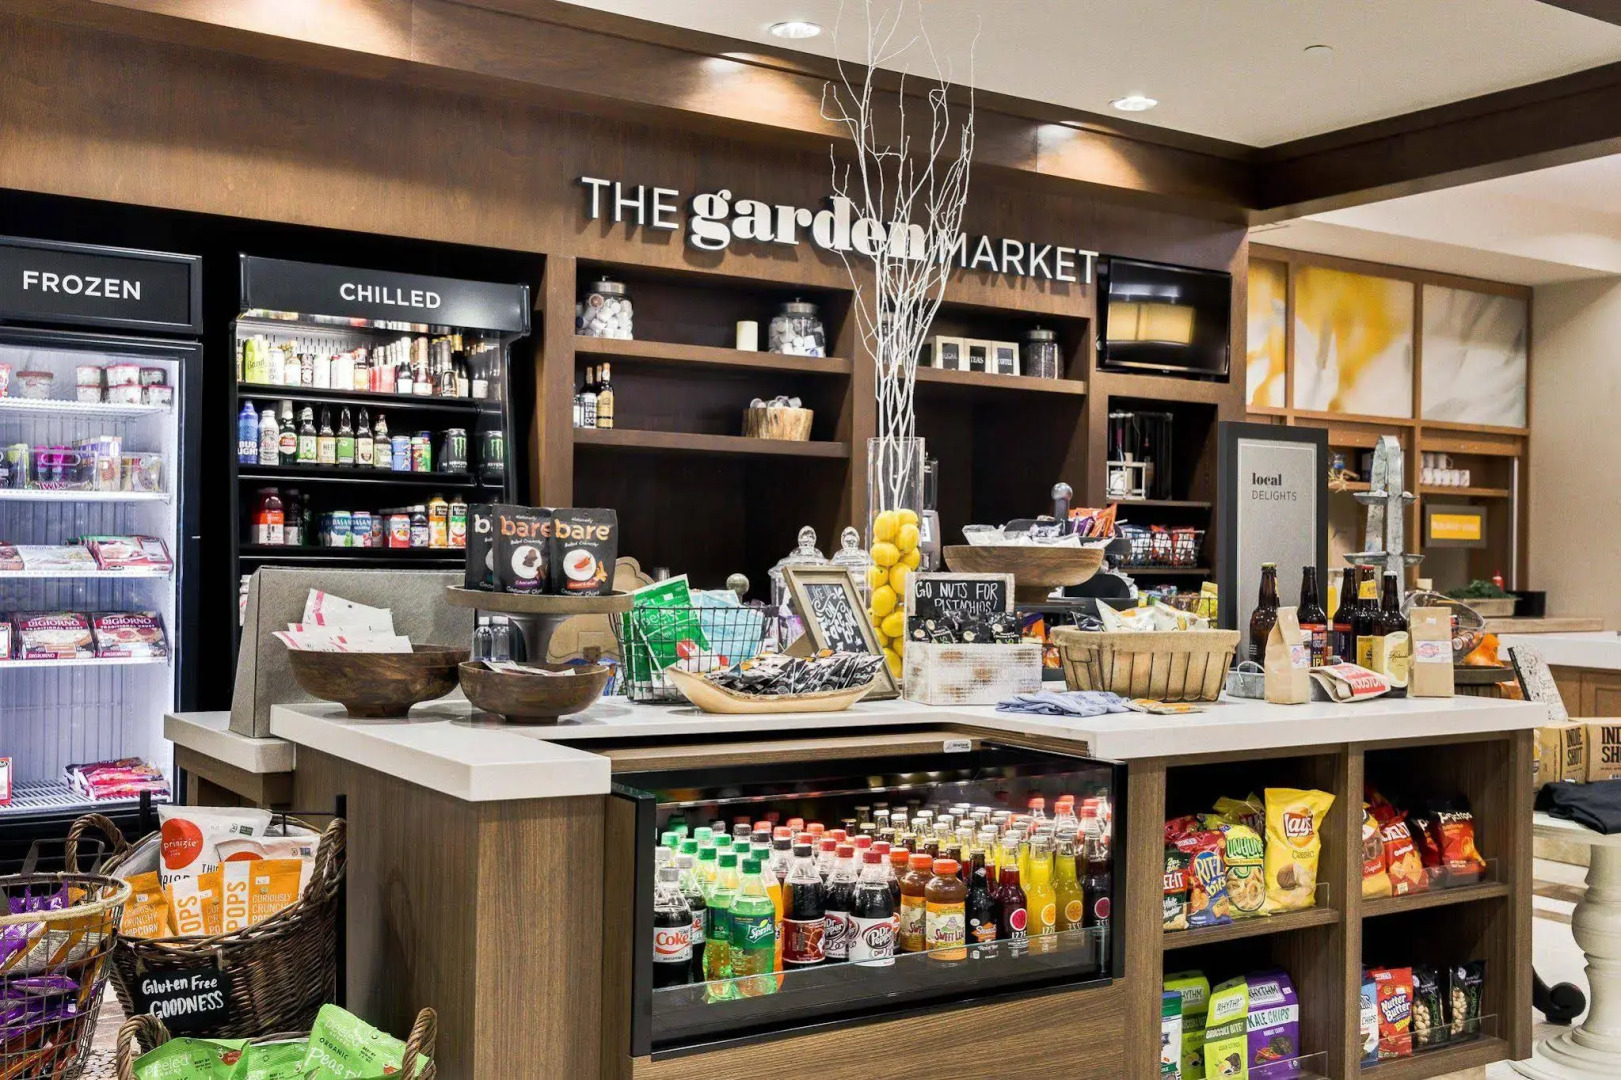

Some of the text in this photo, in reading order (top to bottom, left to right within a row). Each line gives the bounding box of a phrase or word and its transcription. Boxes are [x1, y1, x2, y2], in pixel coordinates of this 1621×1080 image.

[581, 176, 1099, 284] THE garden MARKET
[23, 270, 141, 300] FROZEN
[340, 283, 441, 309] CHILLED
[238, 447, 258, 456] LIGHT
[1252, 472, 1282, 486] local
[1252, 490, 1297, 501] DELIGHTS
[500, 515, 550, 538] bare
[554, 518, 611, 541] bare
[915, 582, 998, 600] GO NUTS FOR
[28, 619, 80, 627] DIGIORNO
[101, 617, 151, 626] DIGIORNO
[1565, 727, 1584, 748] INDIE
[1567, 746, 1583, 767] SHOT
[1284, 813, 1312, 838] Lay's
[1292, 850, 1315, 859] Classic
[1195, 854, 1224, 883] RITZ
[1364, 861, 1382, 873] Original
[1205, 876, 1227, 897] bits
[226, 881, 247, 933] POPS
[252, 892, 292, 902] CURIOUSLY
[177, 895, 201, 935] OPS
[655, 931, 690, 946] Coke
[749, 923, 773, 940] Sprite
[879, 926, 890, 935] Dr
[935, 928, 954, 941] SWEET
[142, 974, 218, 995] Gluten Free
[1182, 988, 1202, 999] HYTHM
[149, 990, 224, 1019] GOODNESS
[1380, 994, 1407, 1012] Nutter
[1385, 1002, 1410, 1022] Butter
[1247, 1007, 1290, 1029] KALE CHIPS
[319, 1037, 349, 1061] ORGANIC
